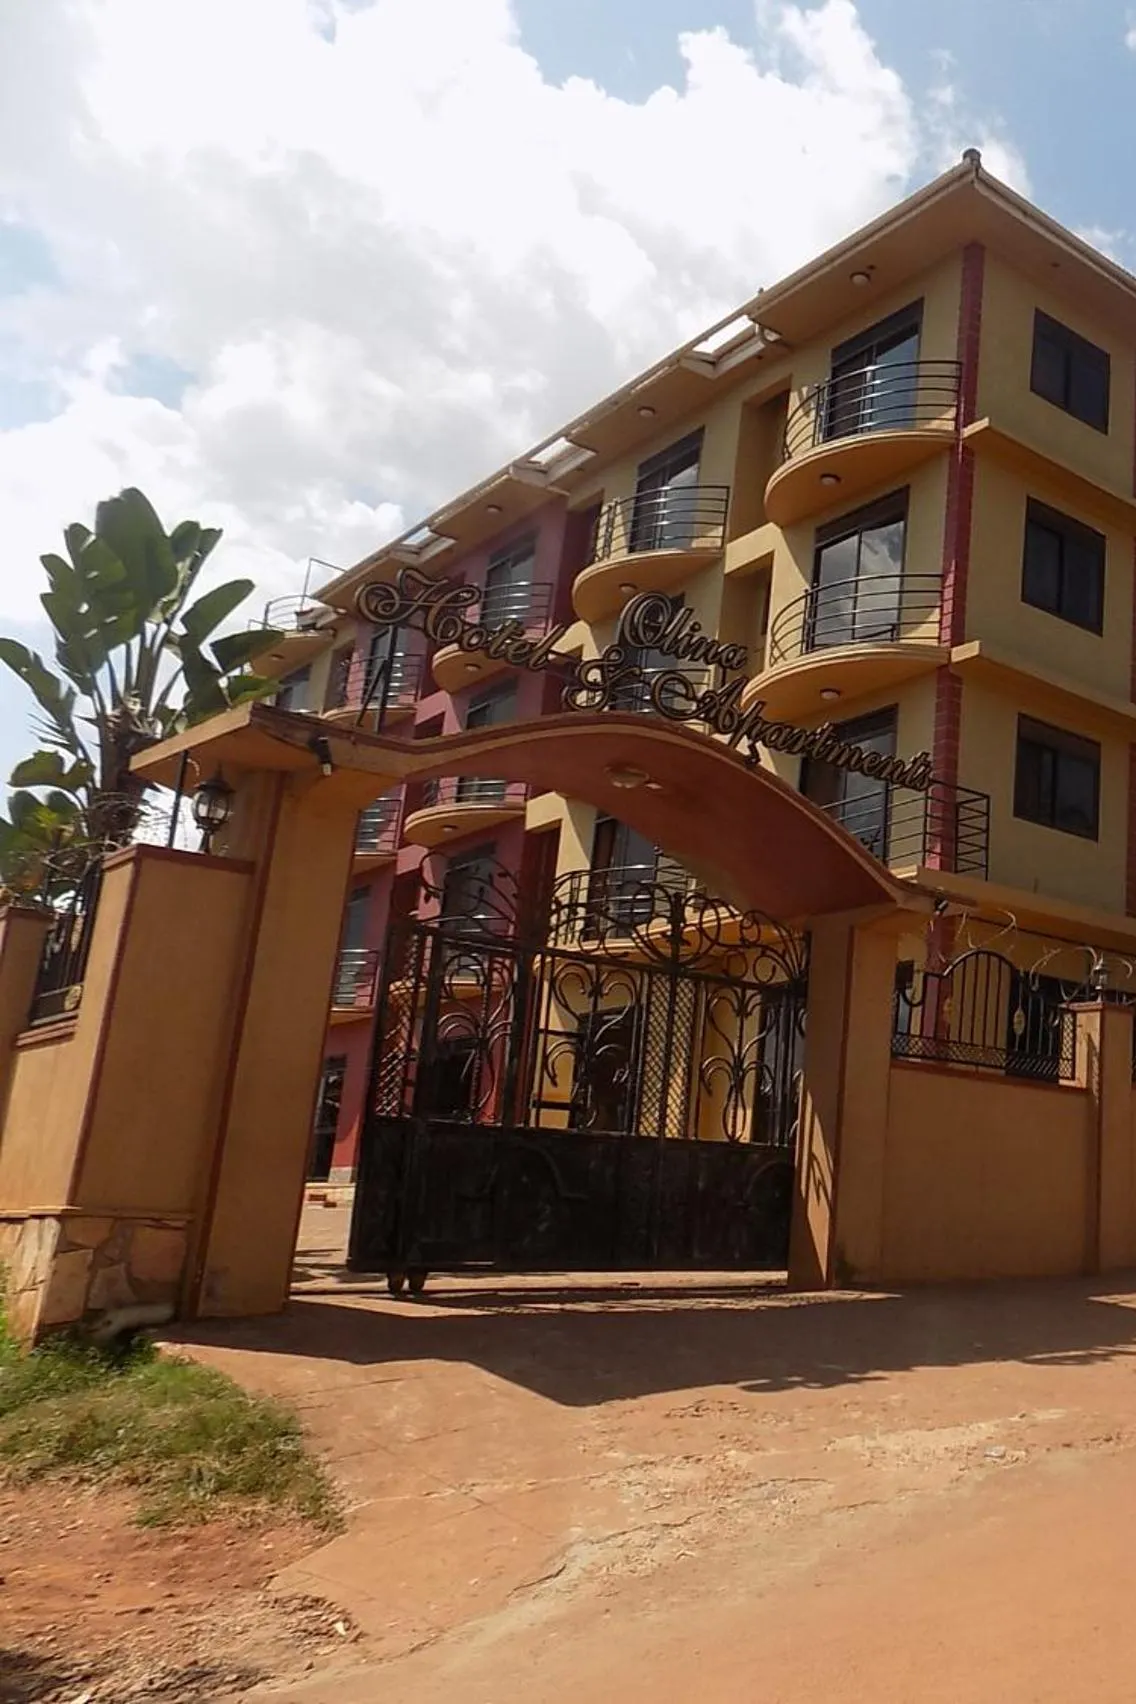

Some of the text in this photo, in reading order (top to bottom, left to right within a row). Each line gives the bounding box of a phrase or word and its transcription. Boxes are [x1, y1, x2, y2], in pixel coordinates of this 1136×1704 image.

[354, 567, 749, 671] Hotel Olina
[650, 671, 935, 791] Apartments
